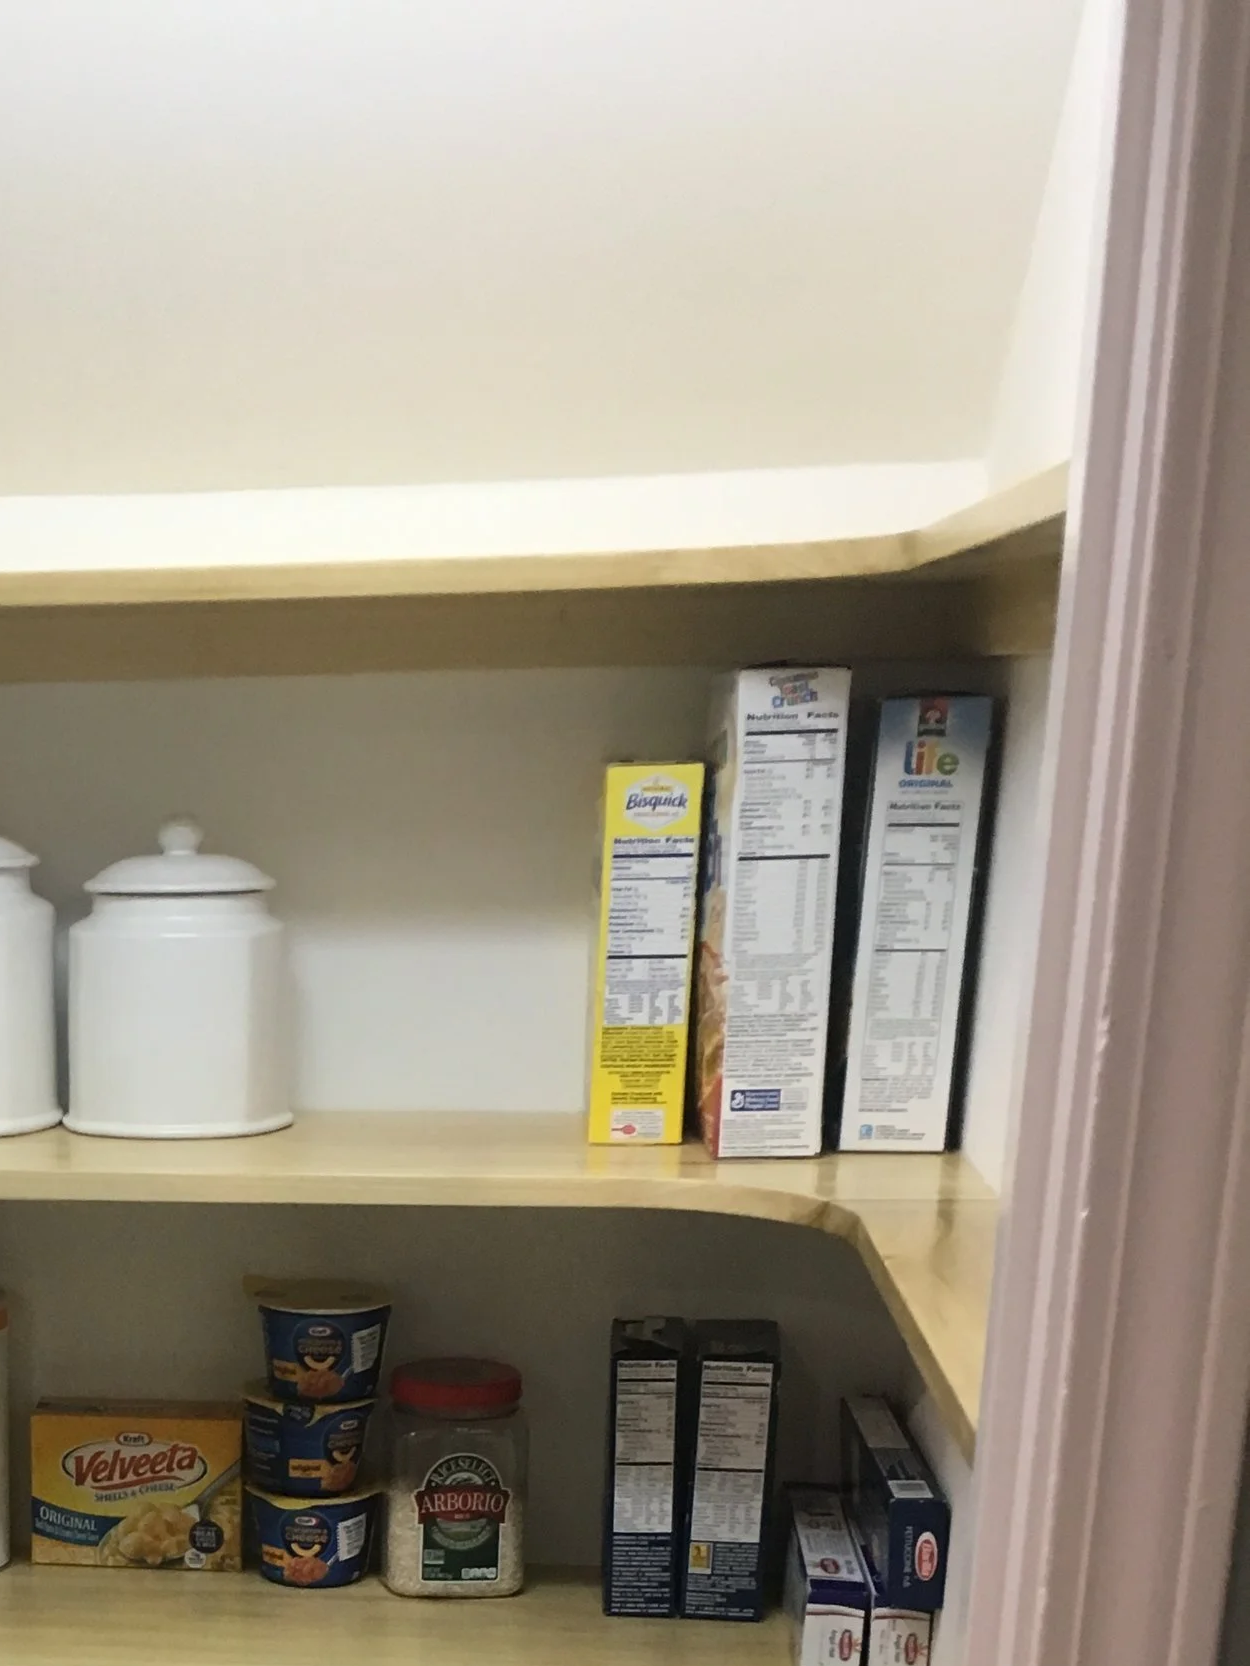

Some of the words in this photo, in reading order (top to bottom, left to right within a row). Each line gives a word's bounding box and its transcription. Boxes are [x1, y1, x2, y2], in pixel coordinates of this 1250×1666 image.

[626, 793, 688, 811] Bisquick
[122, 1434, 145, 1444] Kraft
[74, 1443, 198, 1486] Velveeta
[420, 1491, 504, 1514] ARBORIO
[39, 1505, 97, 1531] ORIGINAL
